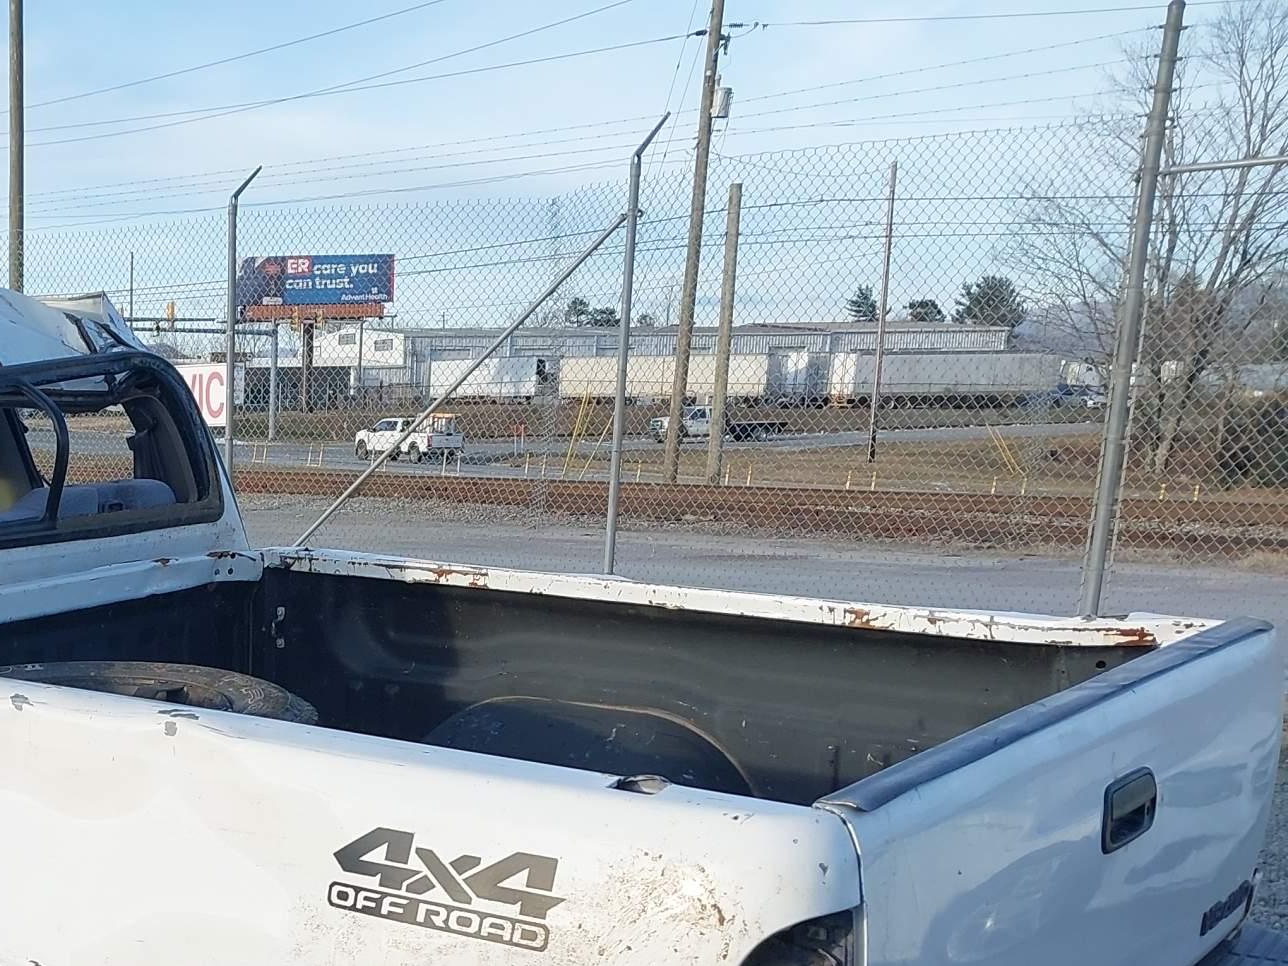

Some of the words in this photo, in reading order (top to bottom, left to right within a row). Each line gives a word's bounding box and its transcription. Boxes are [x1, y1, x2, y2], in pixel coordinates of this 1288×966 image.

[287, 258, 310, 274] ER
[313, 263, 347, 275] care
[350, 263, 378, 276] you
[285, 278, 312, 289] can
[315, 277, 354, 289] trust.
[340, 293, 389, 302] AdventHealth
[329, 884, 411, 916] OFF
[415, 902, 548, 949] ROAD
